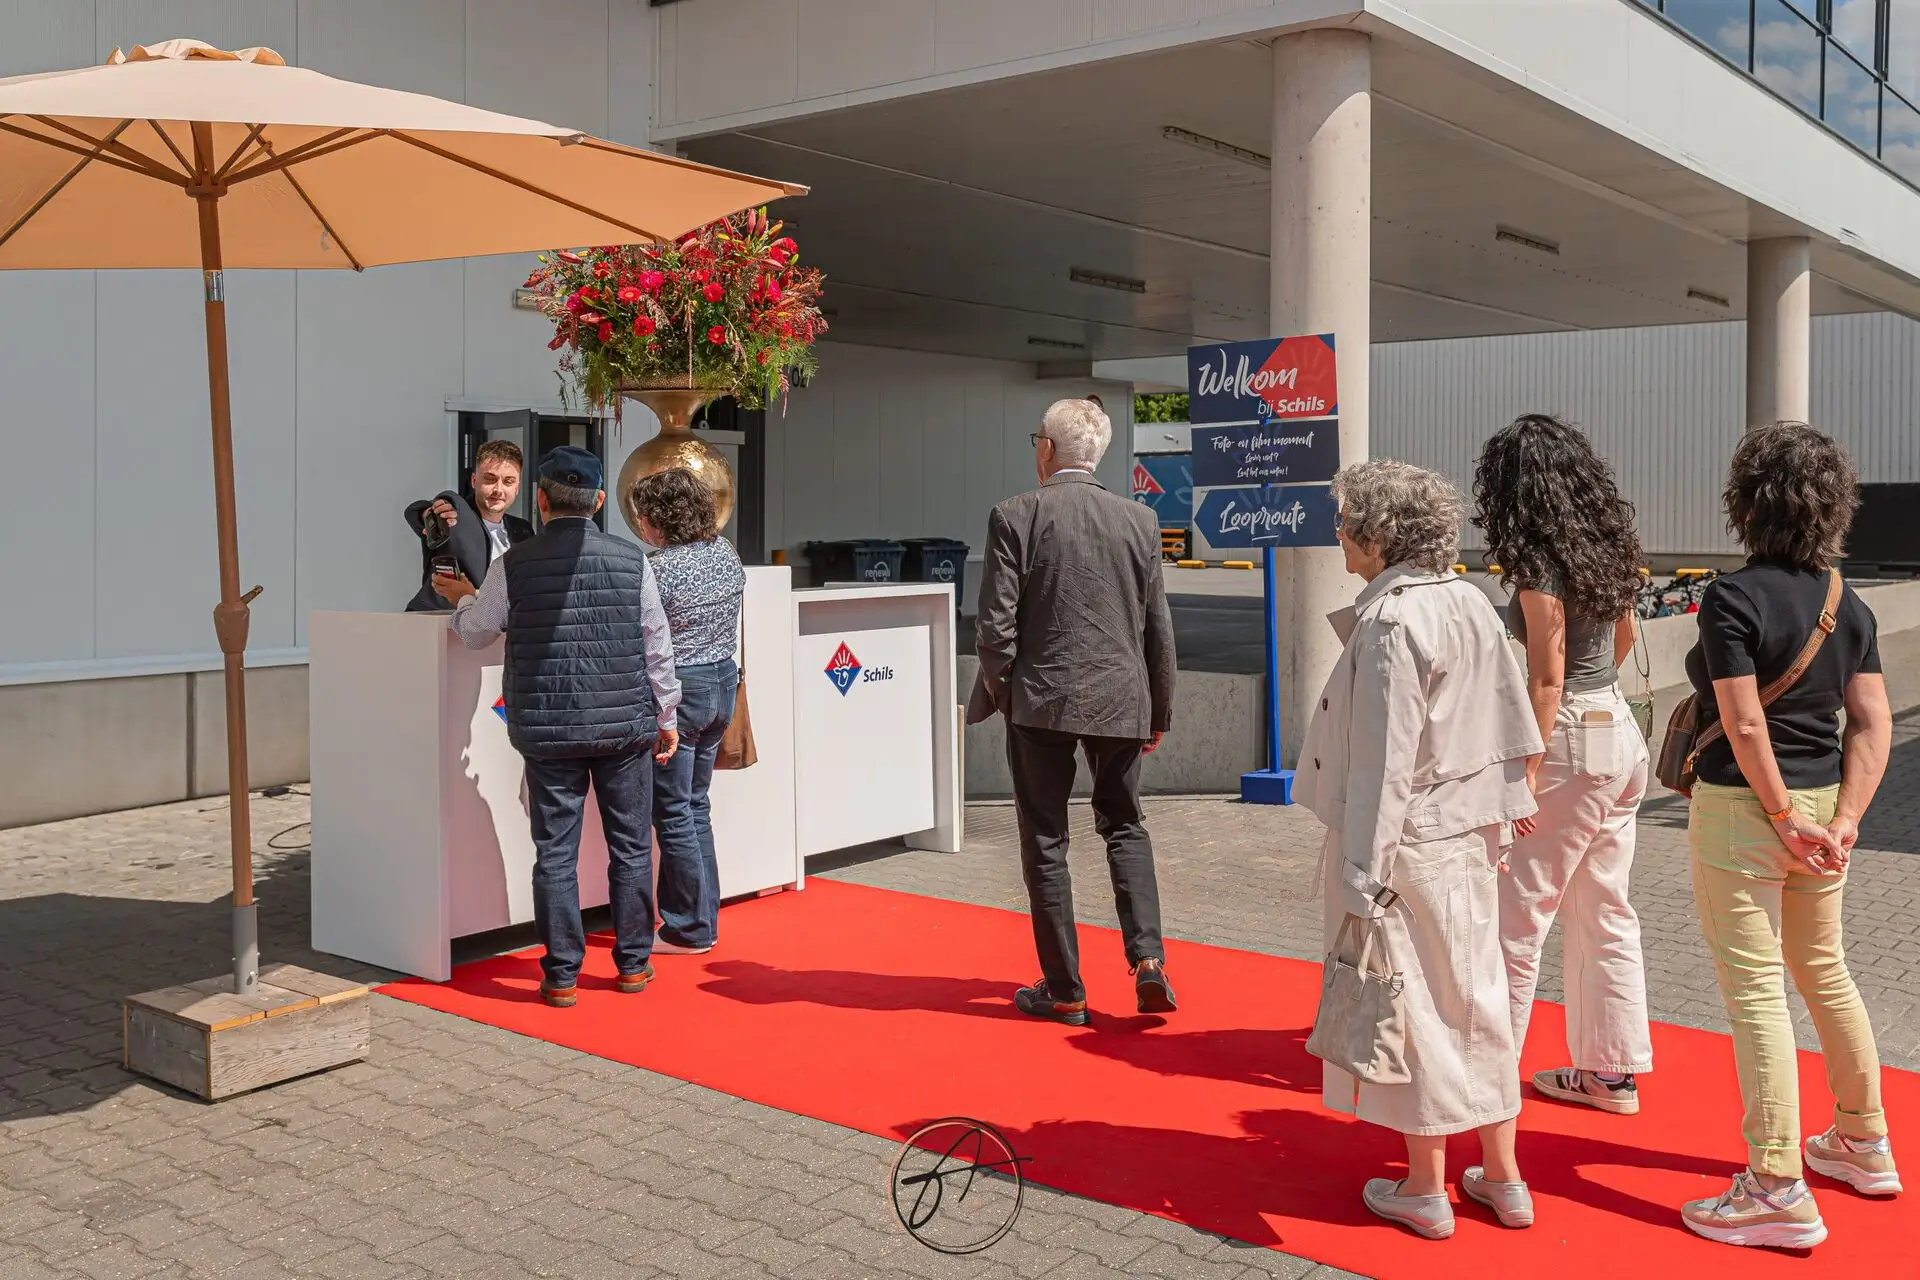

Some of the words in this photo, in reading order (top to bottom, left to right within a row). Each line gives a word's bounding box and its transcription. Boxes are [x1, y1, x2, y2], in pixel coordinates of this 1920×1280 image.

[1198, 348, 1298, 400] Welkom
[1257, 400, 1274, 417] bij
[1276, 396, 1325, 413] Schils
[1210, 435, 1236, 453] Foto-
[1237, 439, 1248, 449] en
[1251, 432, 1271, 451] film
[1273, 431, 1315, 448] moment
[1219, 500, 1306, 534] Looproute
[863, 666, 894, 683] Schils
